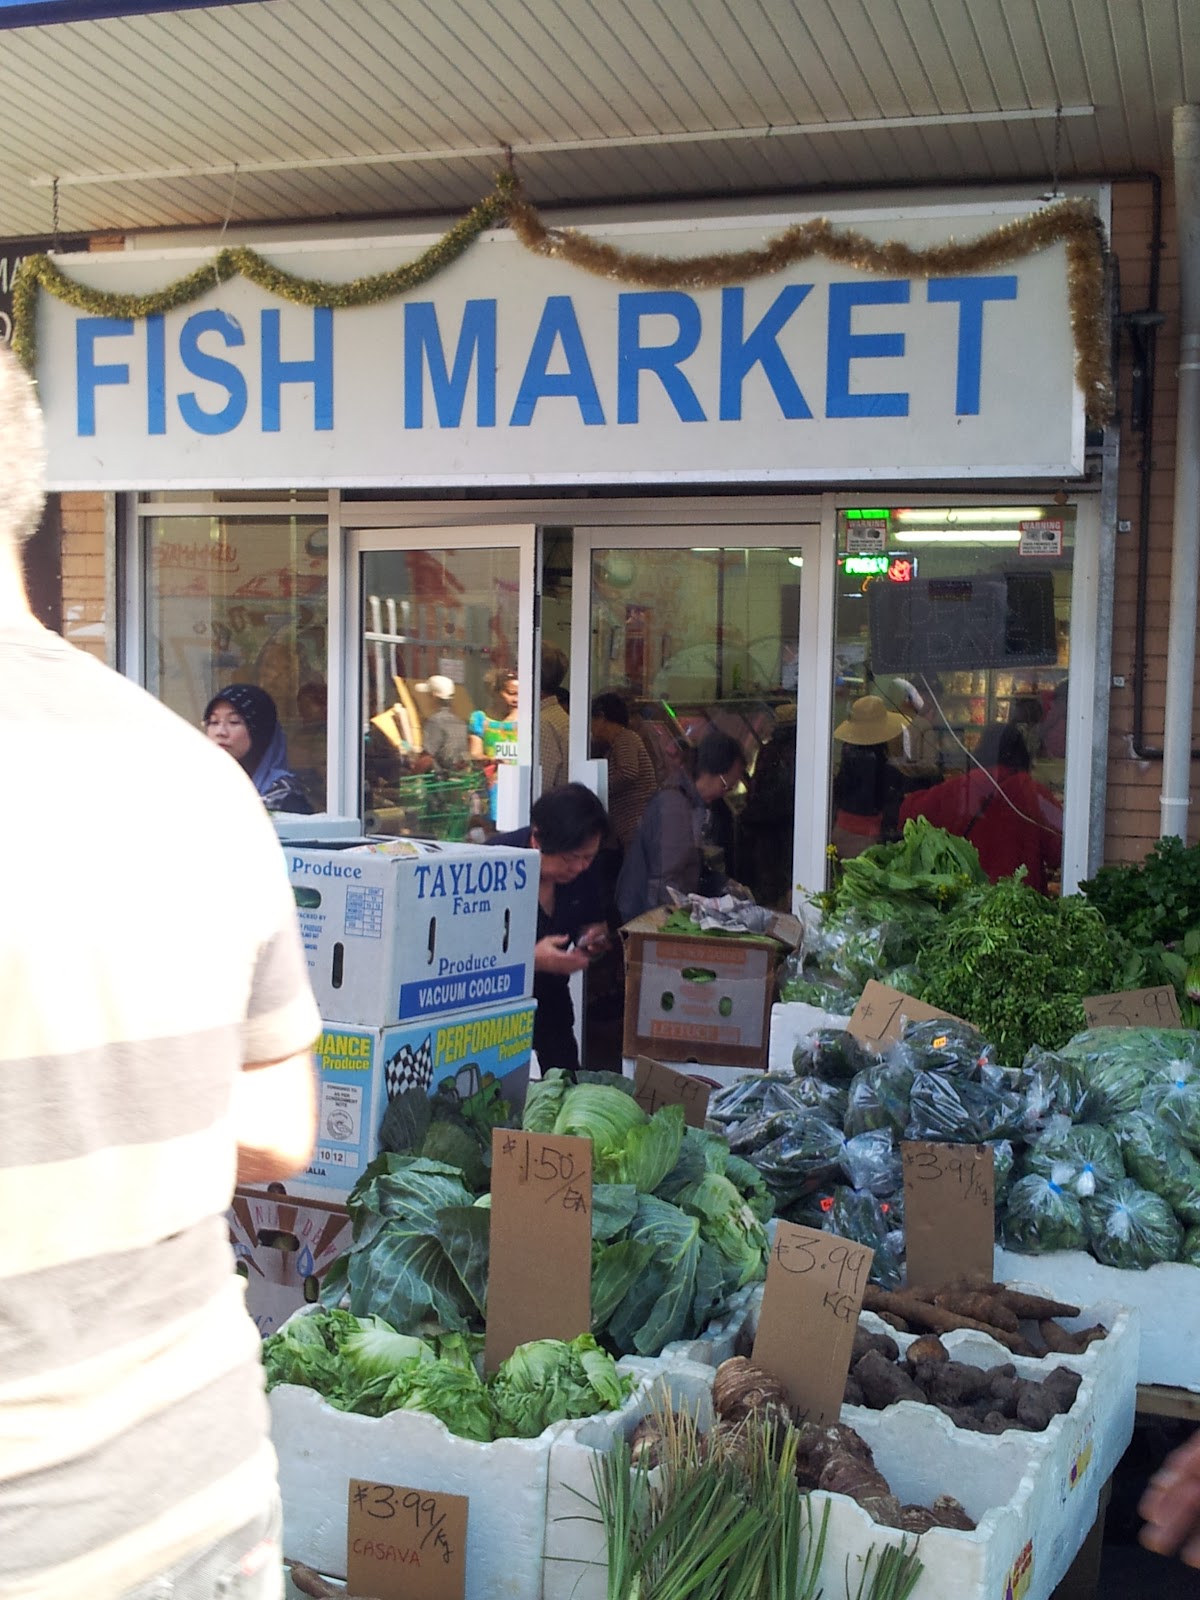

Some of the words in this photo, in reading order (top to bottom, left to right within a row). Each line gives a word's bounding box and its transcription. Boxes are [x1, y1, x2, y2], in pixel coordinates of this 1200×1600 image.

[76, 307, 334, 437] FISH
[404, 275, 1018, 429] MARKET
[1021, 520, 1061, 530] WARNING
[495, 744, 518, 757] PULL
[291, 856, 362, 879] Produce
[414, 859, 527, 899] TAYLOR'S
[452, 897, 492, 915] Farm
[438, 953, 498, 976] Produce
[418, 982, 467, 1009] VACUUM
[469, 974, 511, 999] COOLED
[434, 1010, 534, 1069] PERFORMANCE
[322, 1055, 370, 1071] Produce
[320, 1150, 331, 1160] 10
[333, 1153, 344, 1162] 12
[352, 1538, 421, 1569] CASAVA
